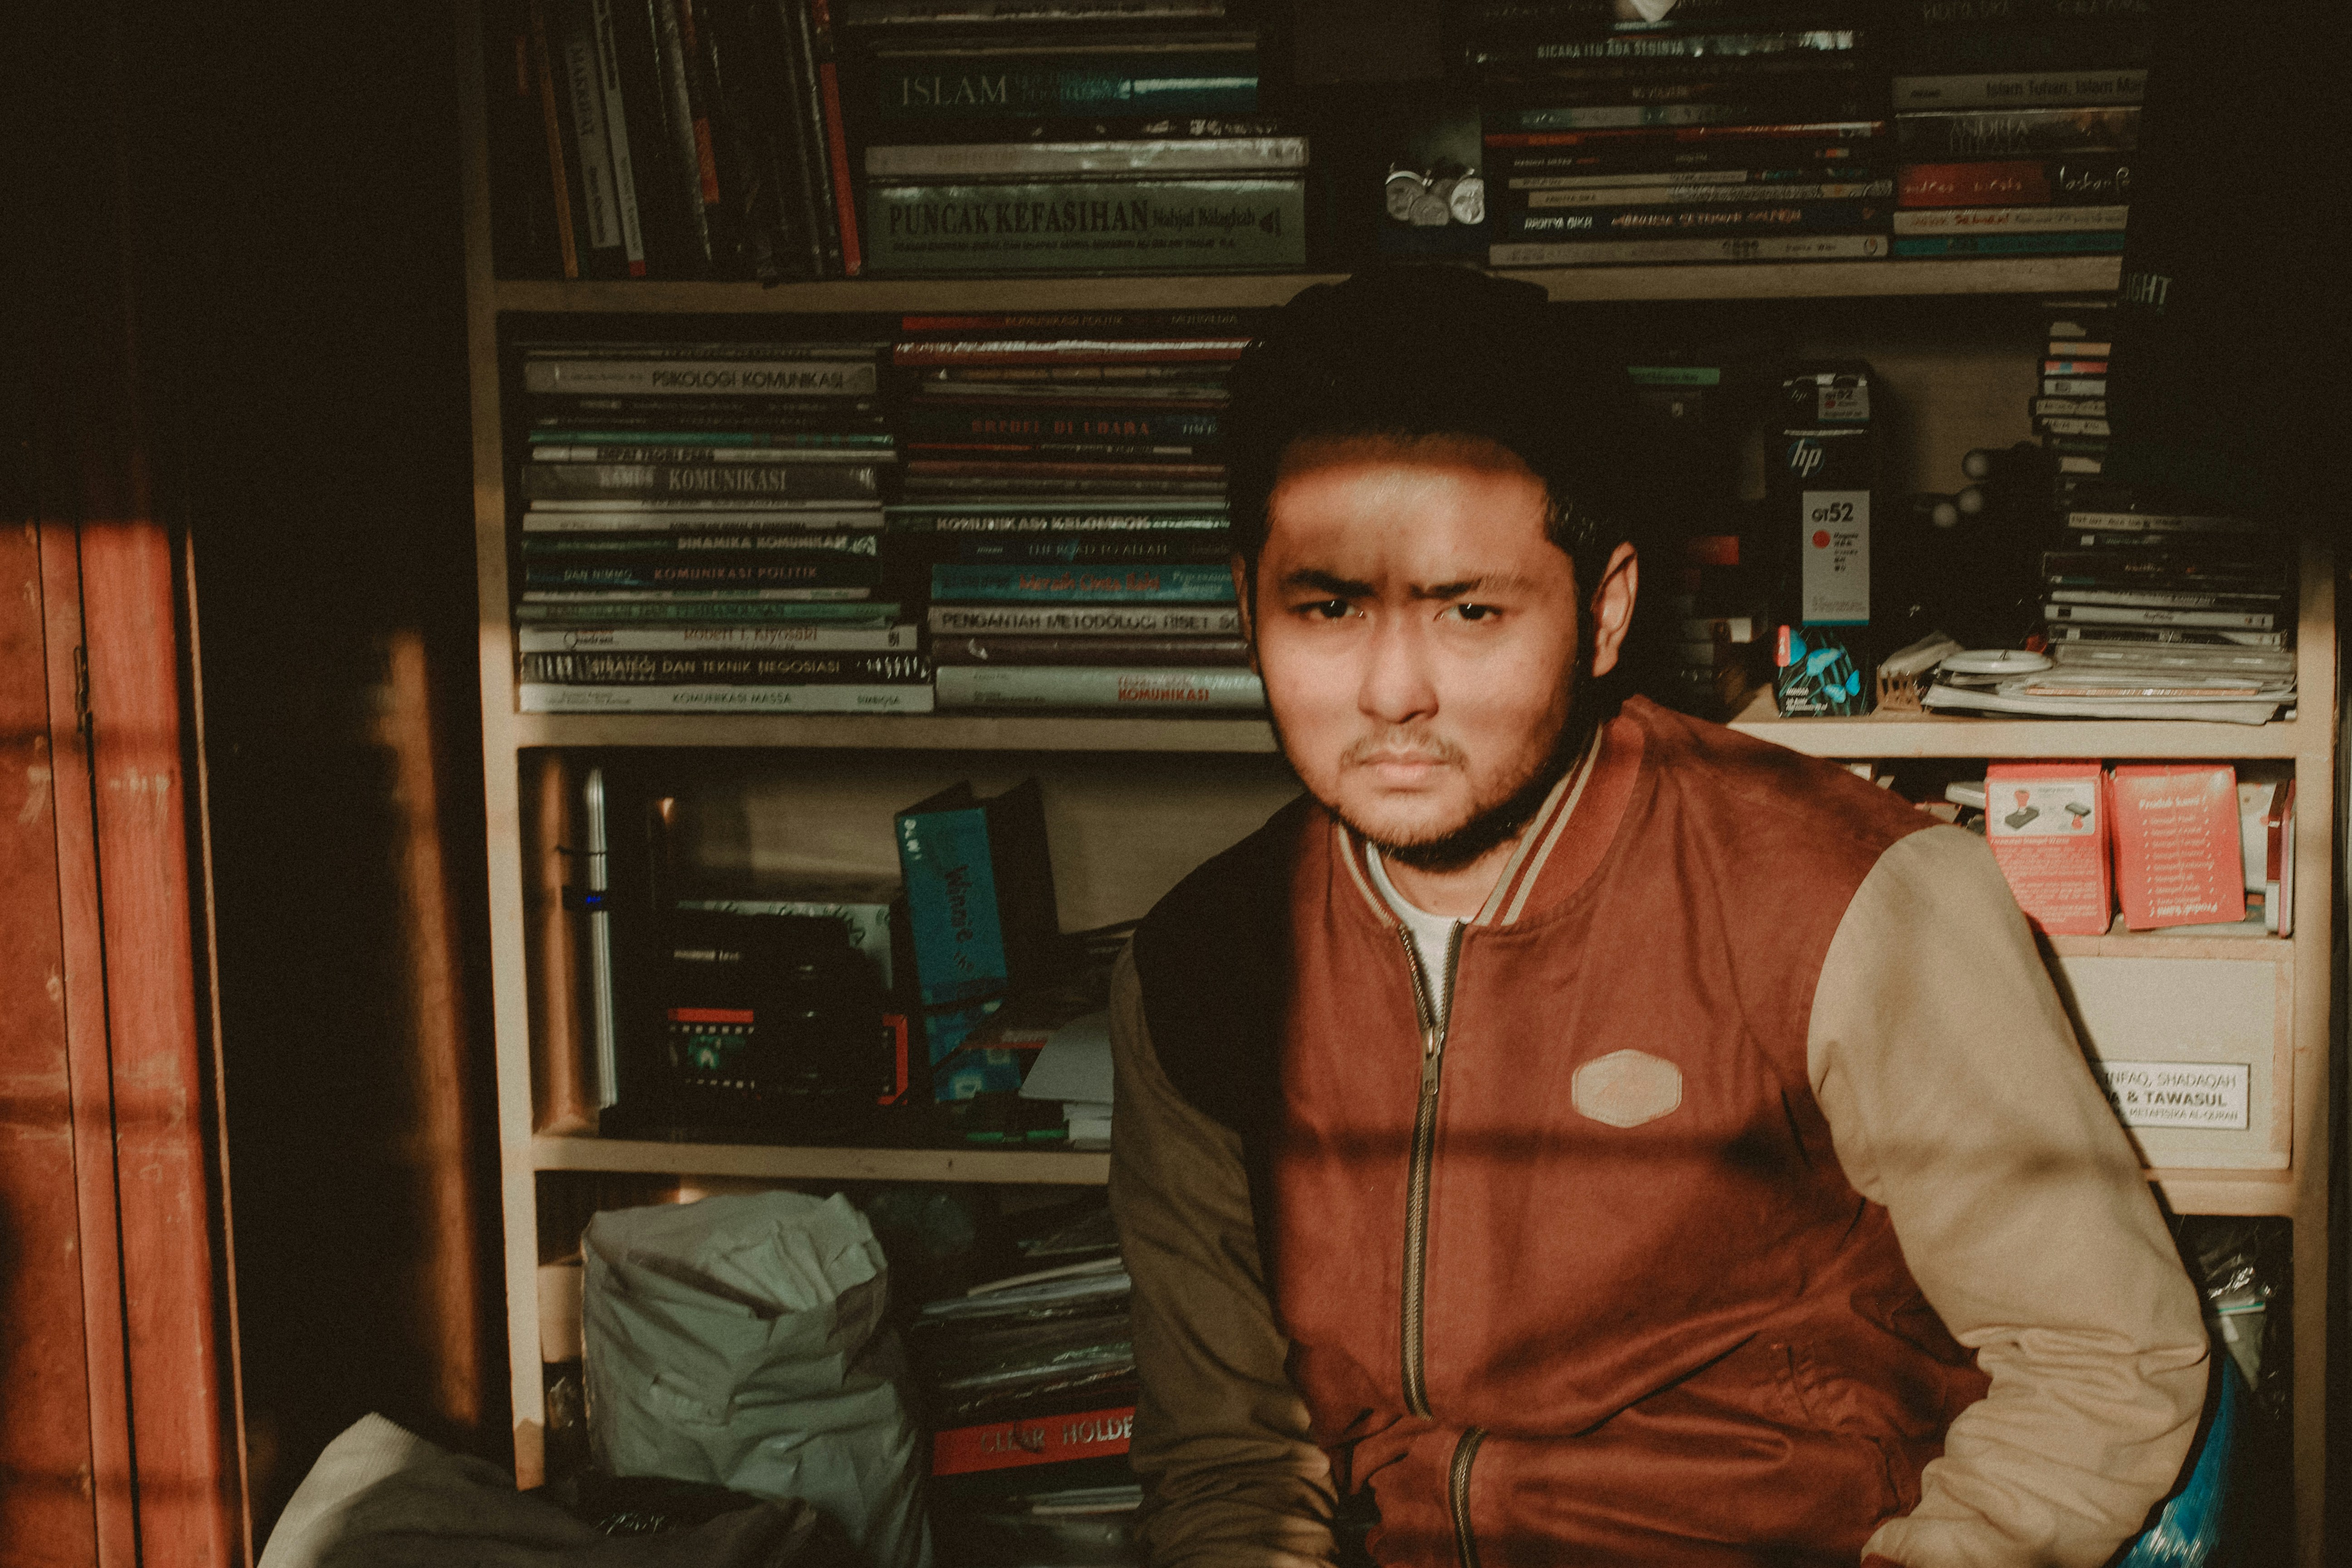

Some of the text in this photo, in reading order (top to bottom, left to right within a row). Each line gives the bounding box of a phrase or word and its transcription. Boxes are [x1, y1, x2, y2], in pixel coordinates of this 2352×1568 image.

[902, 74, 1007, 106] ISLAM
[889, 203, 990, 235] PUNCAK
[996, 200, 1149, 233] KEFASIHAN
[652, 371, 843, 389] PSIKOLOGI KOMUNIKASI
[1791, 438, 1823, 478] hp
[669, 469, 787, 492] KOMUNIKASI
[937, 517, 1048, 531] KOMUNIKASI
[678, 537, 752, 550] DINAMIKA
[654, 567, 818, 580] KOMUNIKASI POLITIK
[1046, 613, 1157, 630] METODOLOGI
[1163, 614, 1210, 630] RISET
[662, 660, 696, 675] DAN
[702, 660, 751, 674] TEKNIK
[758, 659, 841, 675] NEGOSIASI
[672, 692, 792, 704] KOMUNIKASI MASSA
[1118, 689, 1210, 701] KOMUNIKASI
[2157, 1072, 2236, 1088] SHADAQAH
[2127, 1091, 2138, 1103] &
[2144, 1091, 2228, 1107] TAWASUL
[1062, 1415, 1134, 1446] HOLDE
